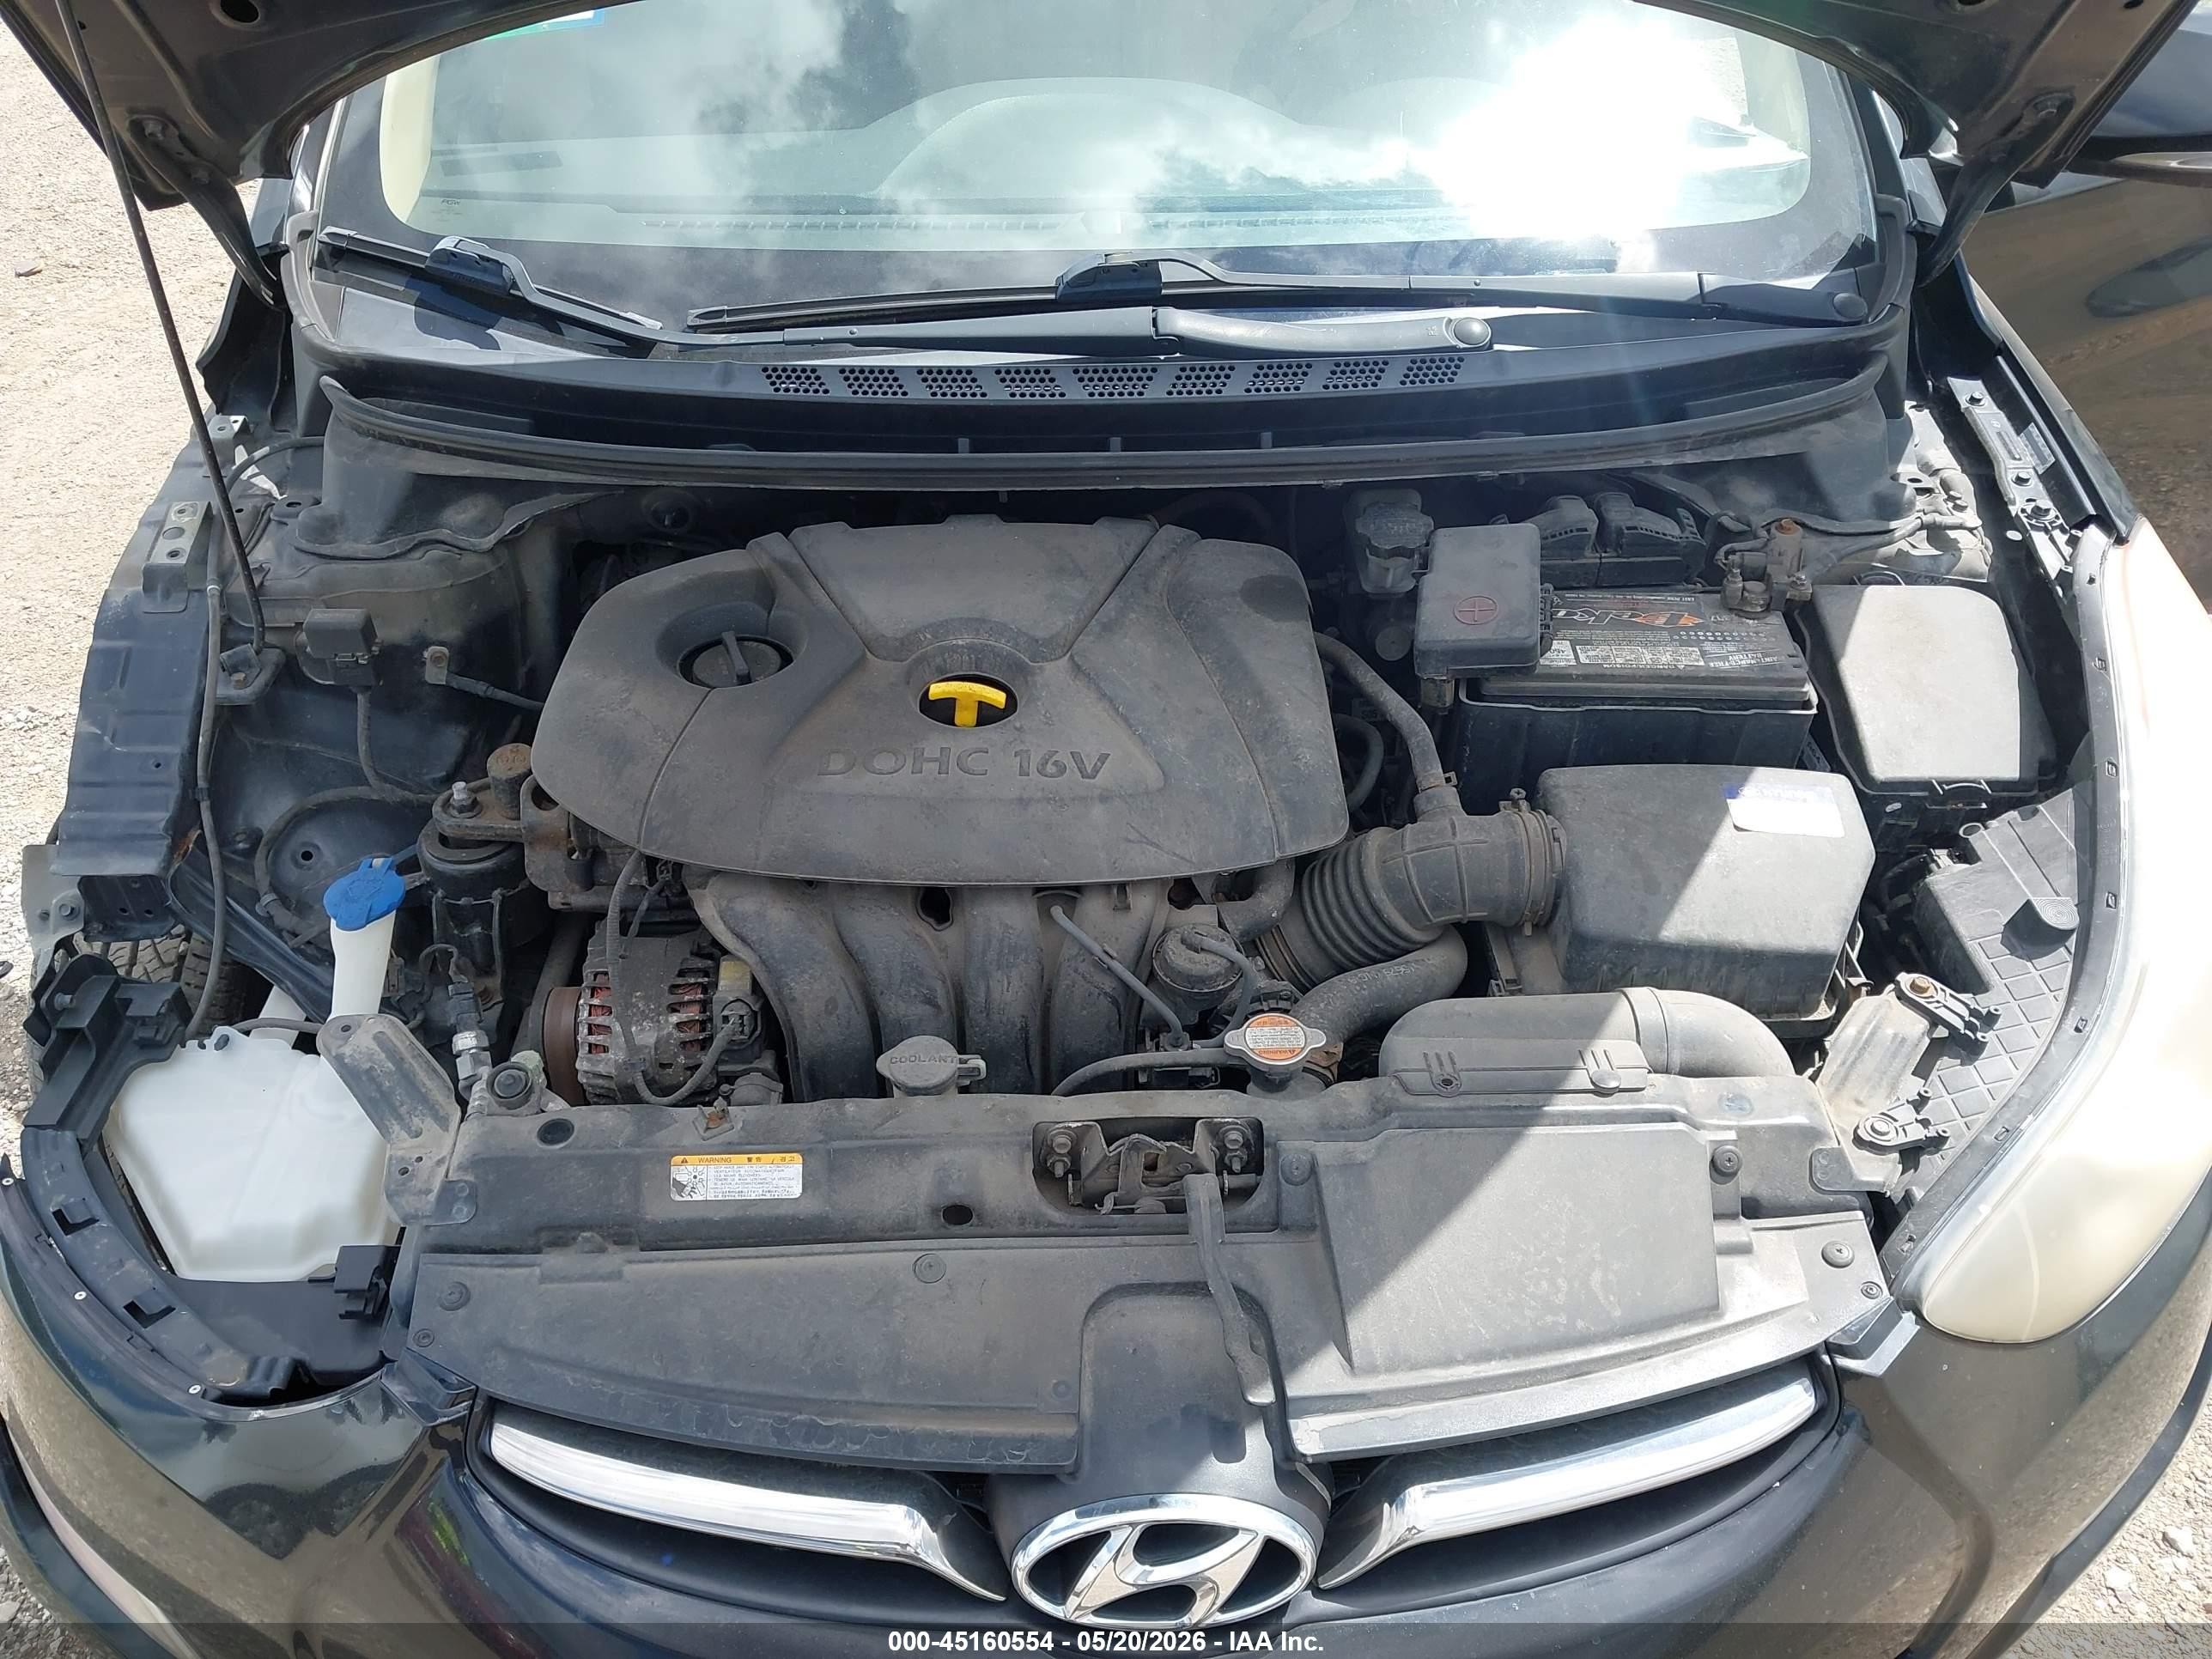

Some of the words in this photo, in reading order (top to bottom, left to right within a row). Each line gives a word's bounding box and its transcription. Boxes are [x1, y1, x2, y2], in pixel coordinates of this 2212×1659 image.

[817, 746, 990, 776] DOHC
[1013, 748, 1112, 780] 16V
[890, 1054, 957, 1065] COOLANT
